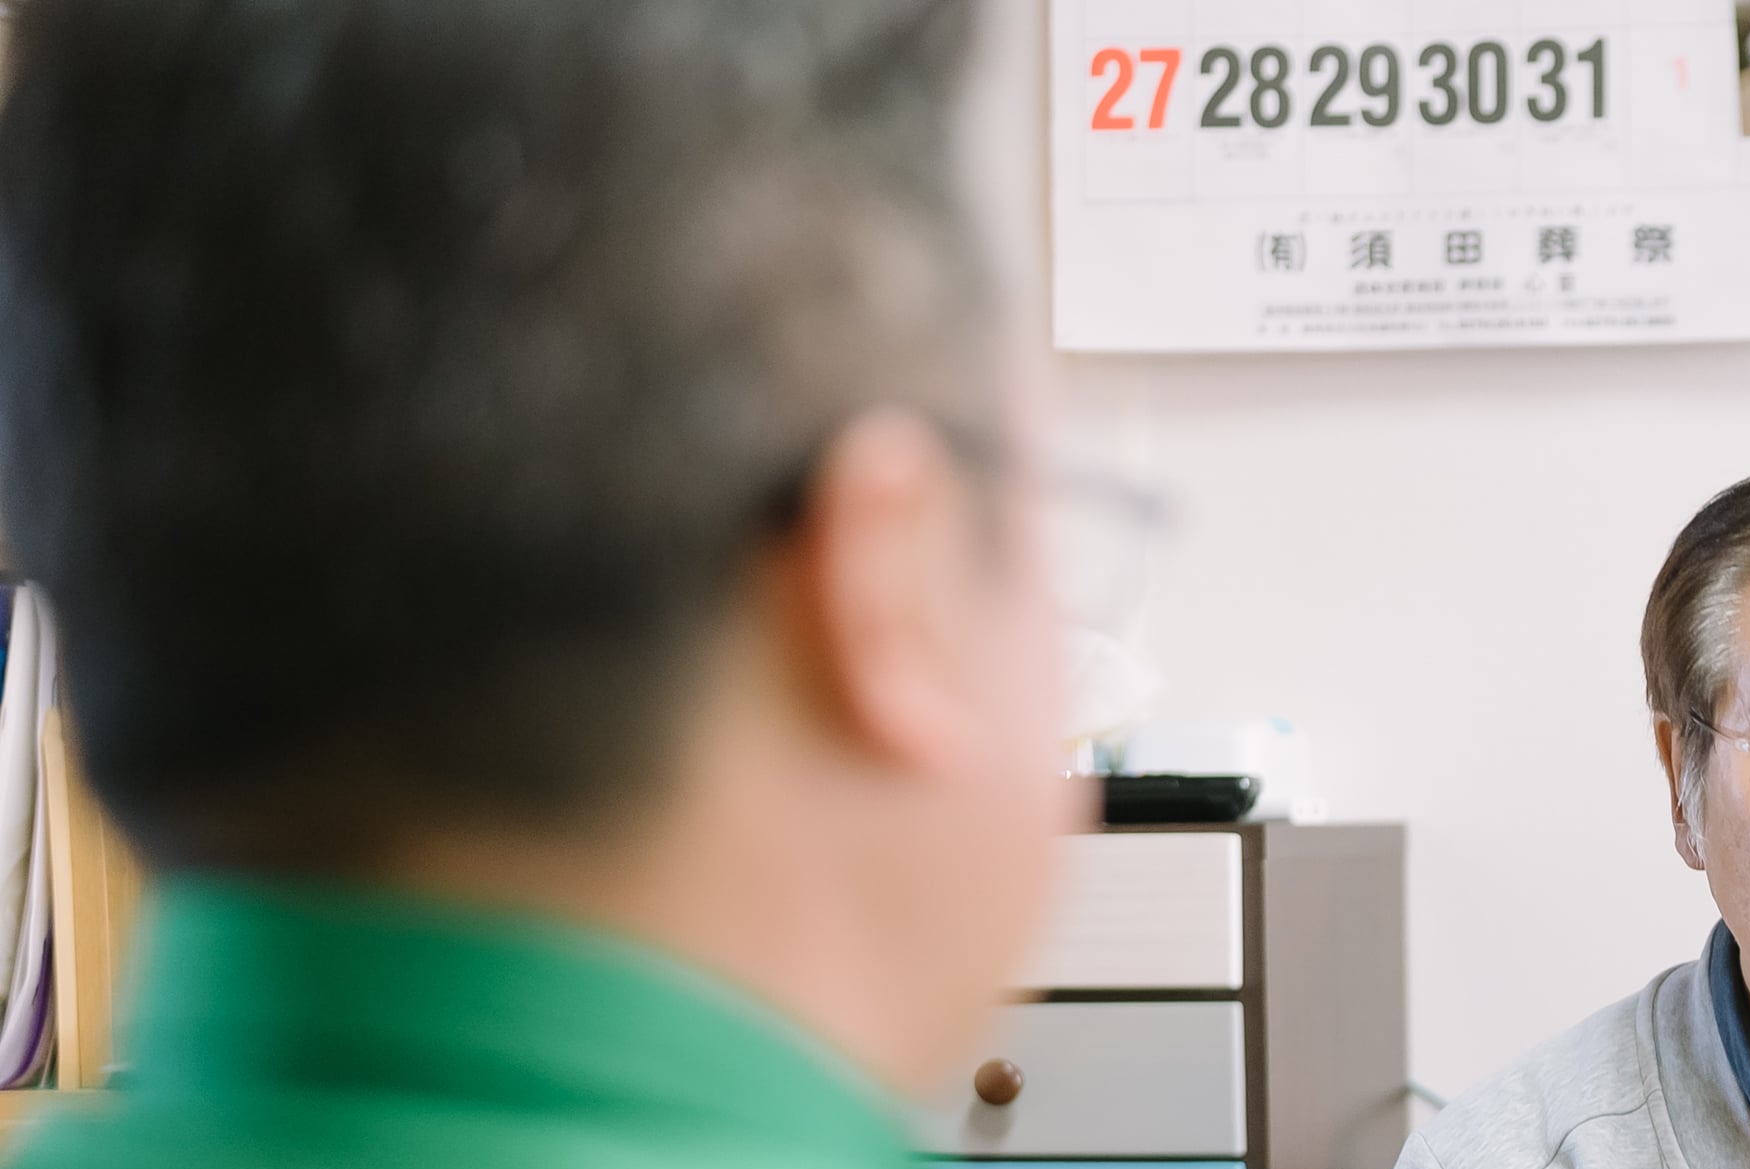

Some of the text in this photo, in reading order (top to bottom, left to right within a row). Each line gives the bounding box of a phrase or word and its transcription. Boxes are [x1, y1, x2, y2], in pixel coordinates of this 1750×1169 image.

[1089, 46, 1182, 131] 27
[1200, 46, 1291, 129] 28
[1309, 44, 1401, 128] 29
[1418, 41, 1509, 126] 30
[1527, 38, 1605, 122] 31
